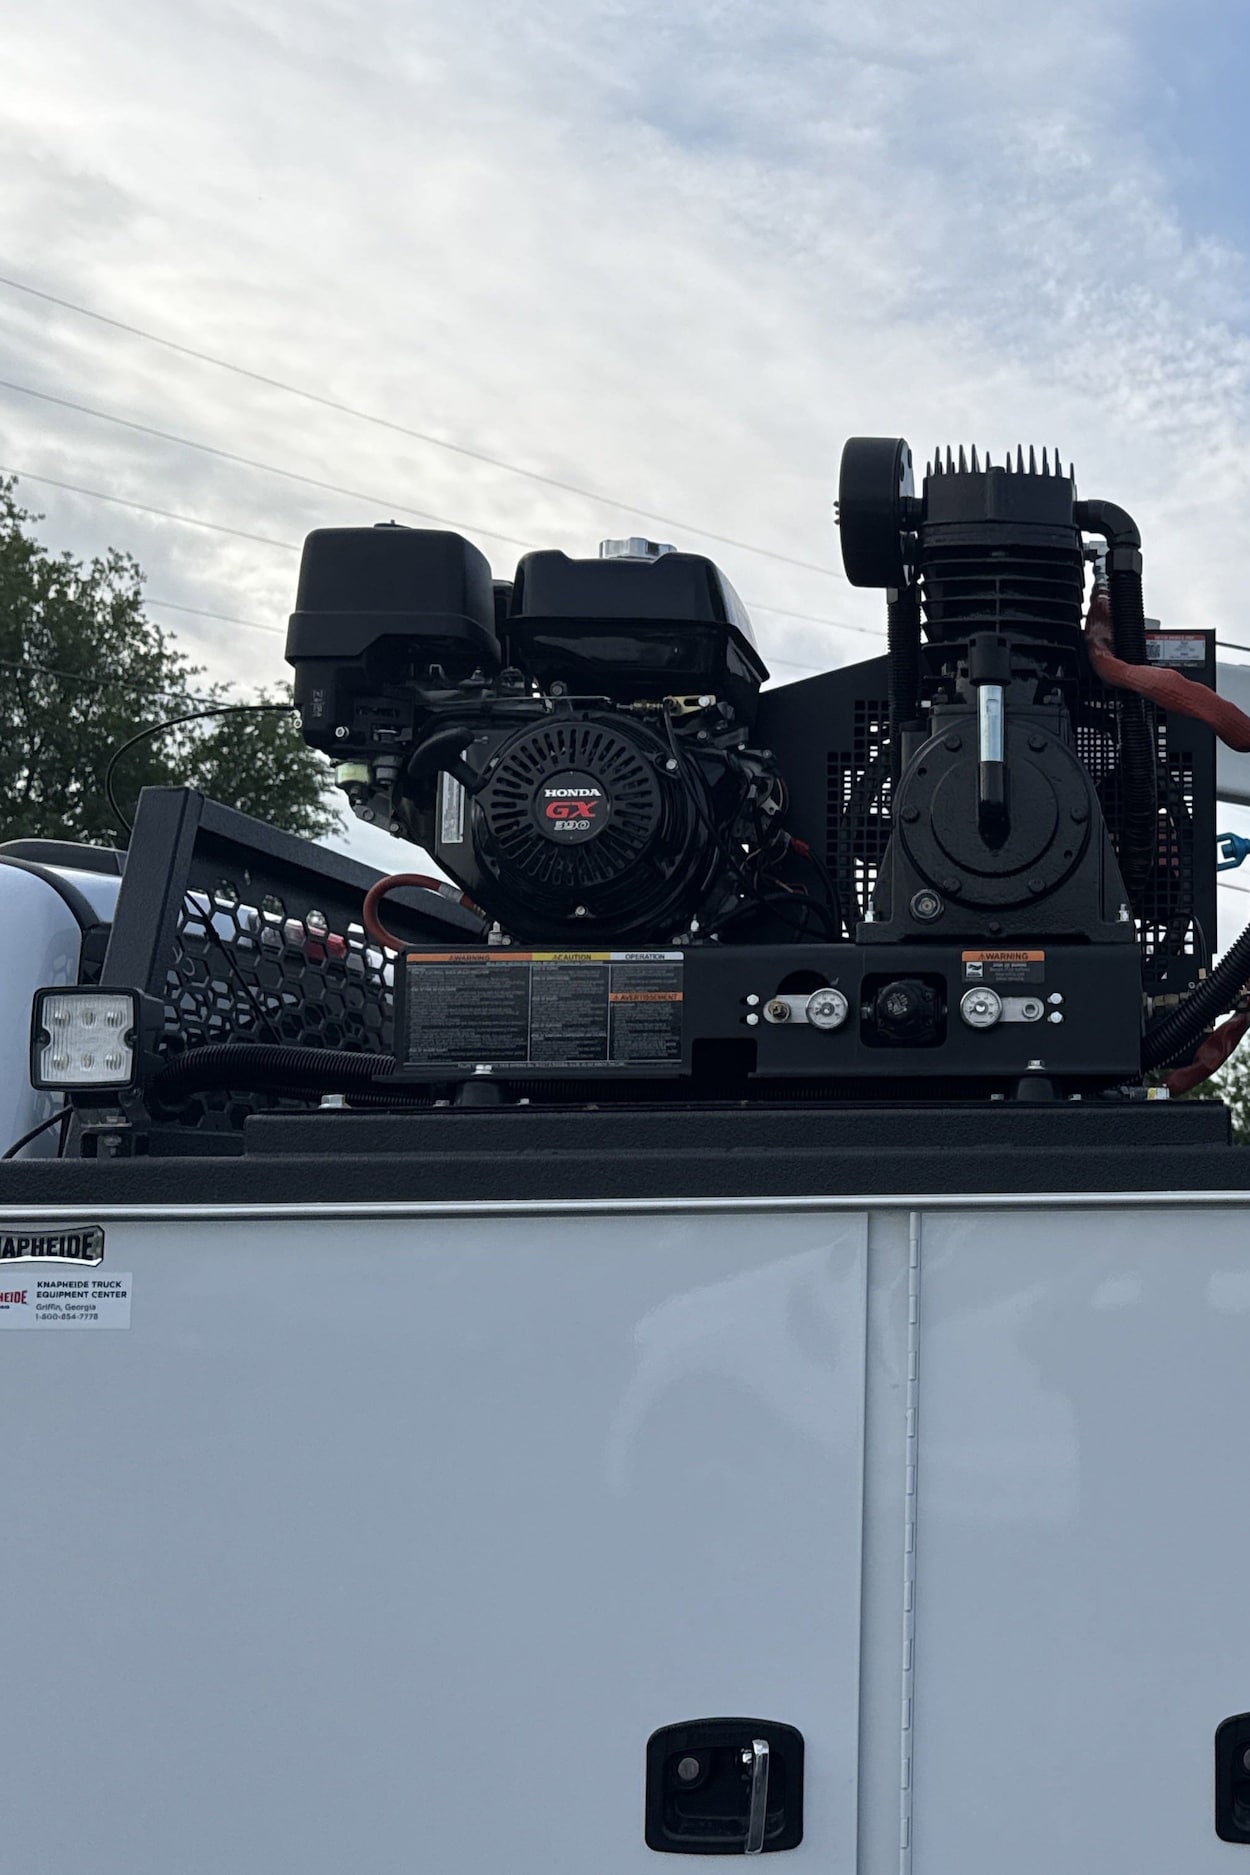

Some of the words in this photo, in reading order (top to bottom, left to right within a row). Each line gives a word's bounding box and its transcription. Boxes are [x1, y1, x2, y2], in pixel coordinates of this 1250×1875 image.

[544, 788, 601, 798] HONDA
[545, 801, 599, 819] GX
[553, 820, 590, 831] 390
[985, 952, 1029, 960] WARNING
[0, 1232, 95, 1260] APHEIDE
[64, 1304, 97, 1312] Georgia
